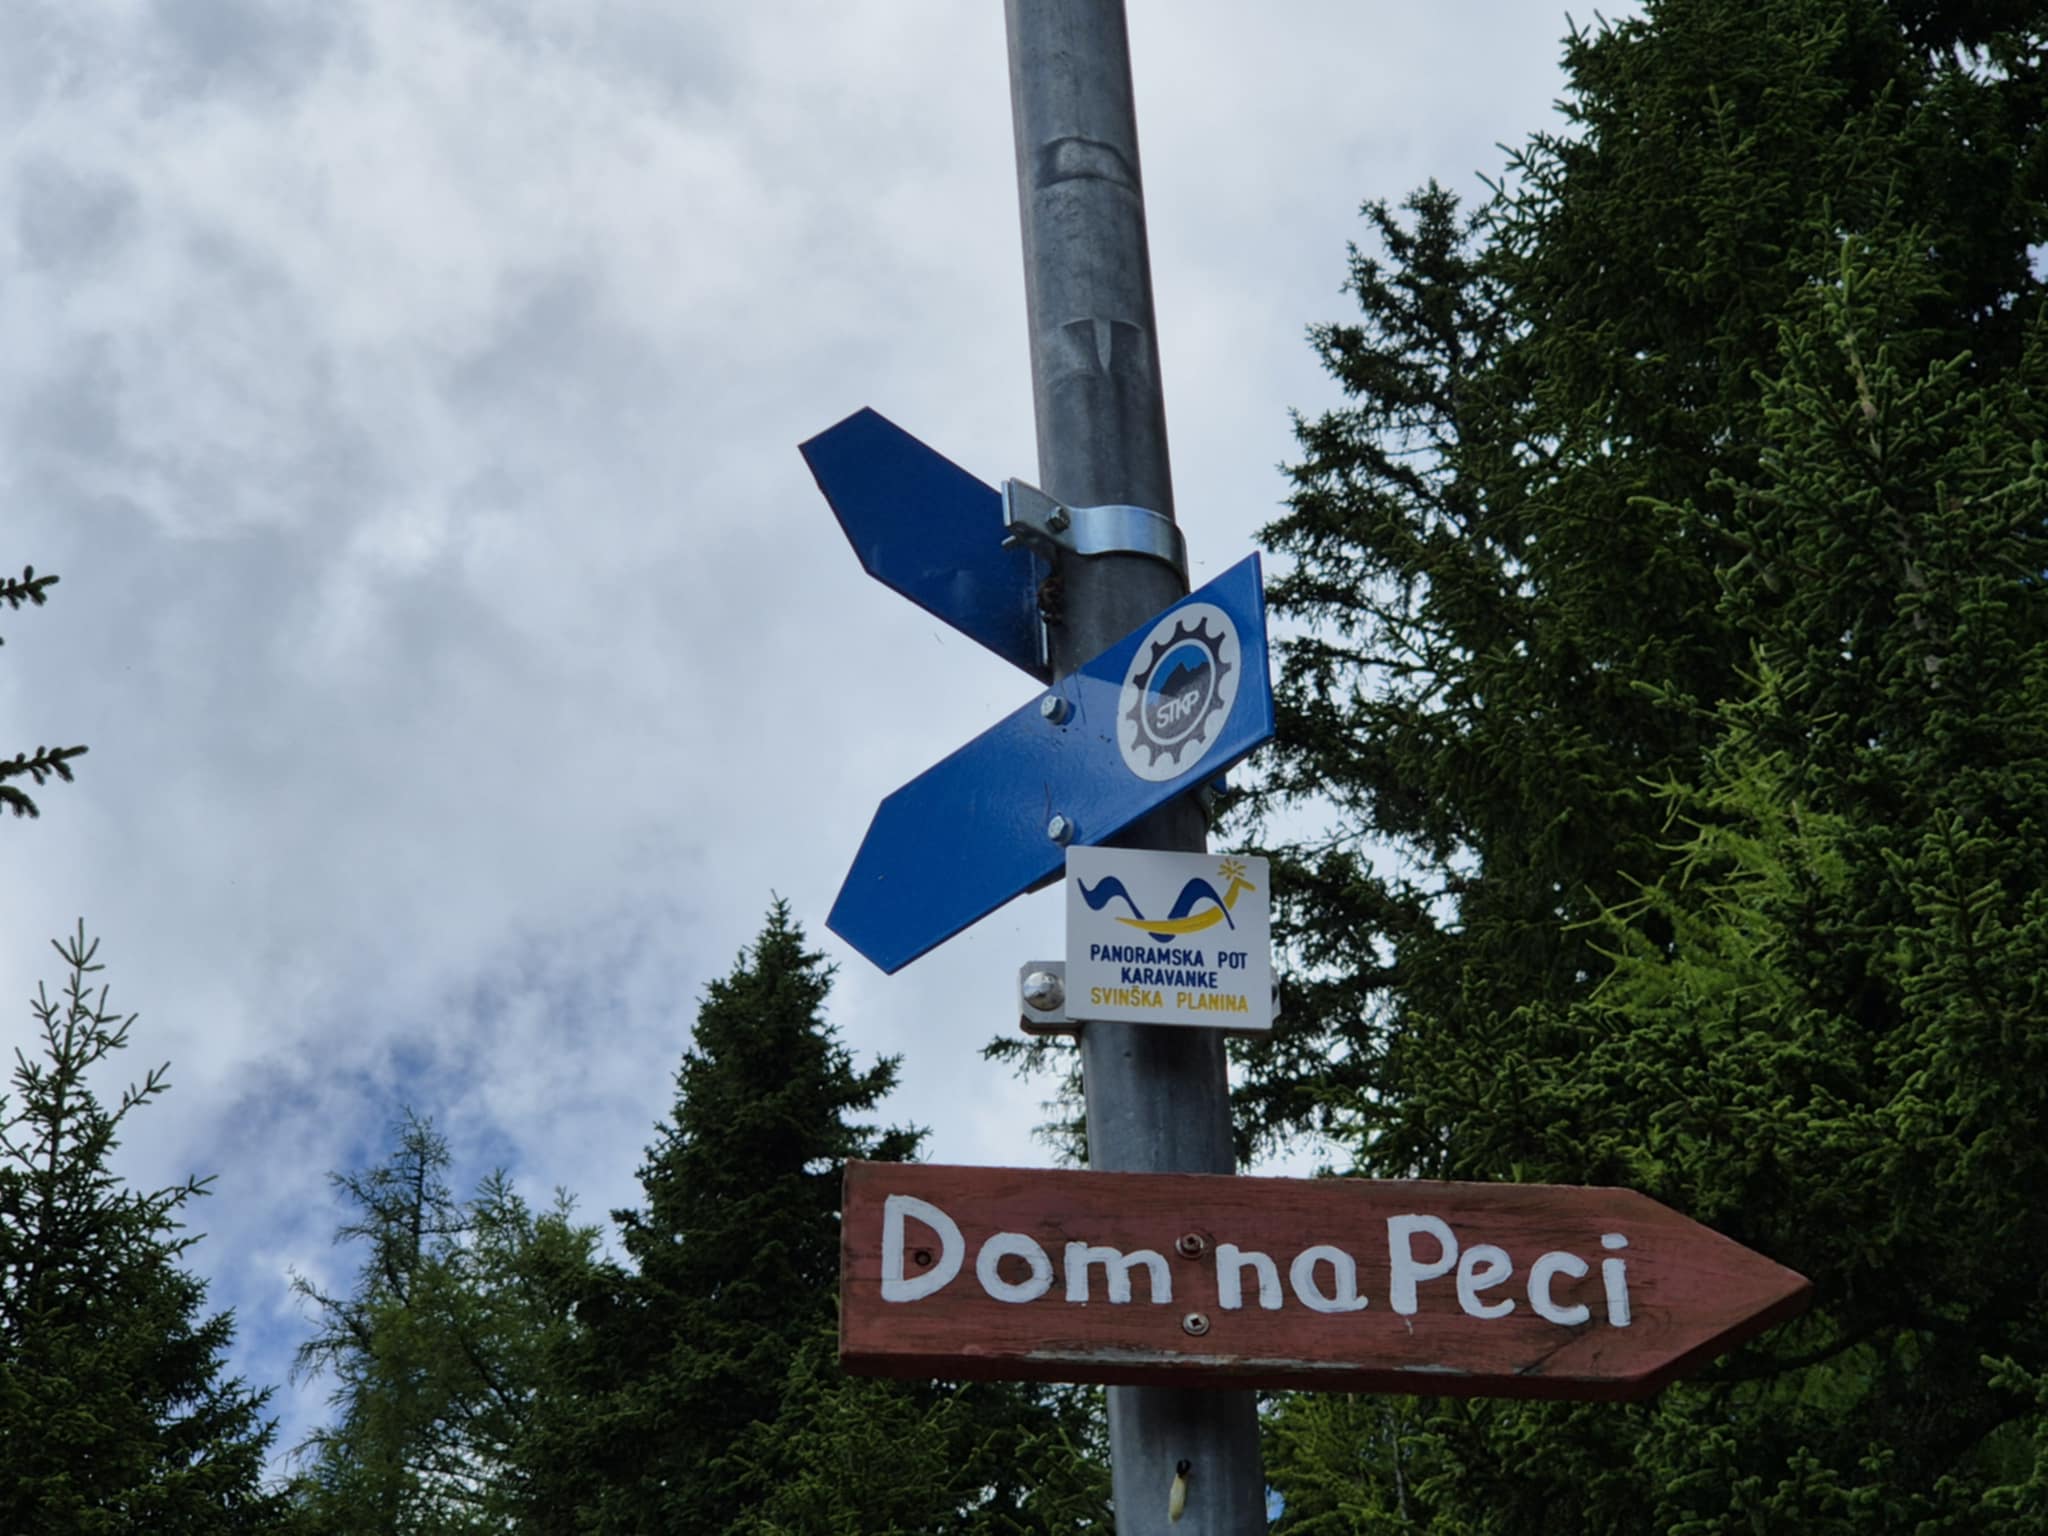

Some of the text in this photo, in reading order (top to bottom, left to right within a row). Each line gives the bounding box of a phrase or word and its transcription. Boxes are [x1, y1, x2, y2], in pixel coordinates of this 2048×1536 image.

[1156, 690, 1200, 729] STKP
[1090, 944, 1248, 970] PANORAMSKA POT
[1121, 967, 1218, 989] KARAVANKE
[1090, 986, 1249, 1013] SVINŠKA PLANINA
[881, 1194, 1631, 1327] Dom na Peci
